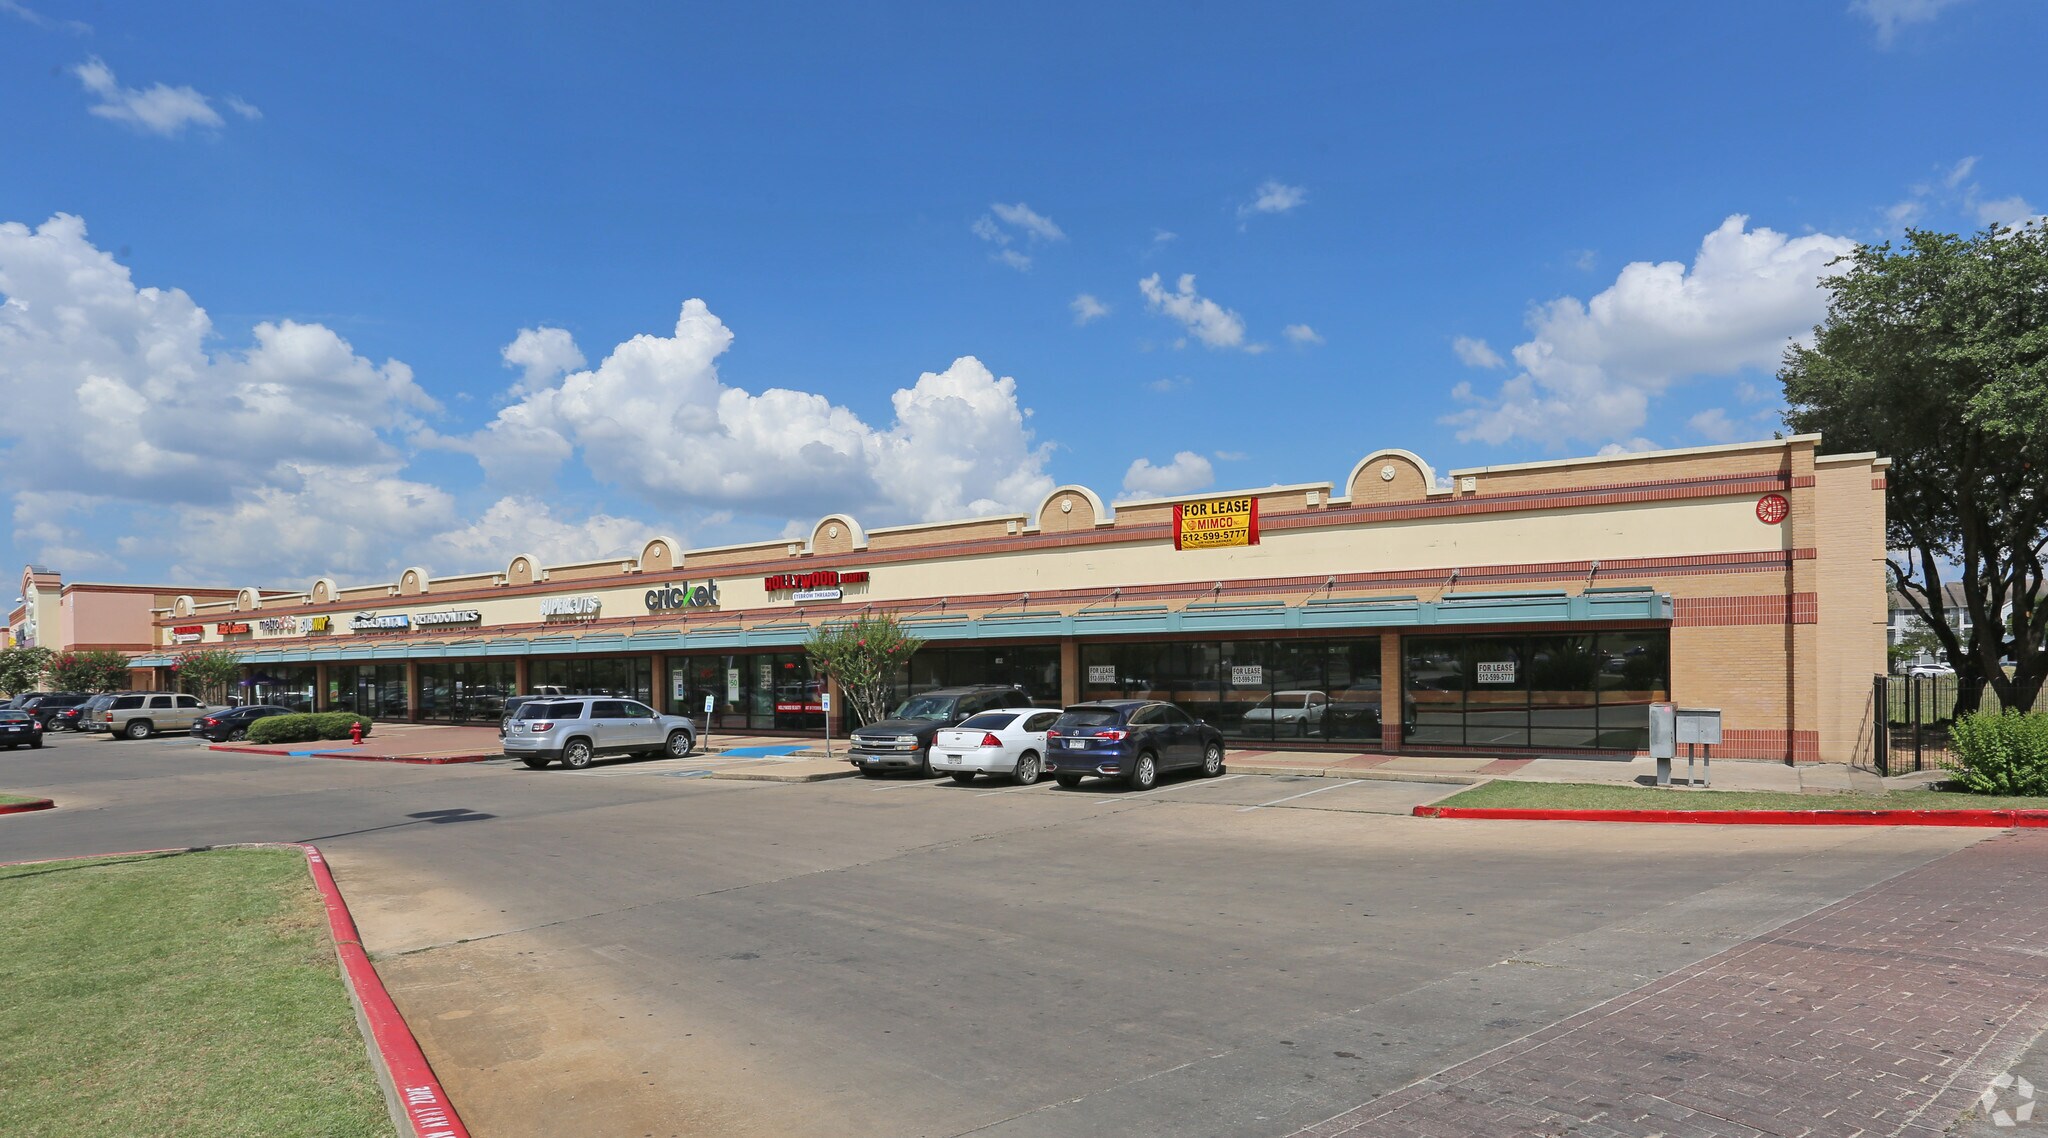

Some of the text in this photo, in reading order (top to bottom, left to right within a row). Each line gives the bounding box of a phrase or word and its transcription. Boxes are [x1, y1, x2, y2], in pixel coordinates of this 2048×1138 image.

[1184, 500, 1249, 517] FOR LEASE
[1197, 517, 1233, 530] MIMCO
[1182, 529, 1247, 542] 512-599-5777
[764, 571, 870, 592] HOLLYWOOD BEAUTY
[645, 579, 717, 610] cricket
[793, 590, 839, 600] EYEBROW THREADING
[541, 596, 599, 615] SUPERCUTS
[300, 615, 331, 632] SUBWAY
[1233, 667, 1261, 675] FOR LEASE
[1479, 663, 1513, 672] FOR LEASE
[1478, 673, 1514, 681] 512-599-5777
